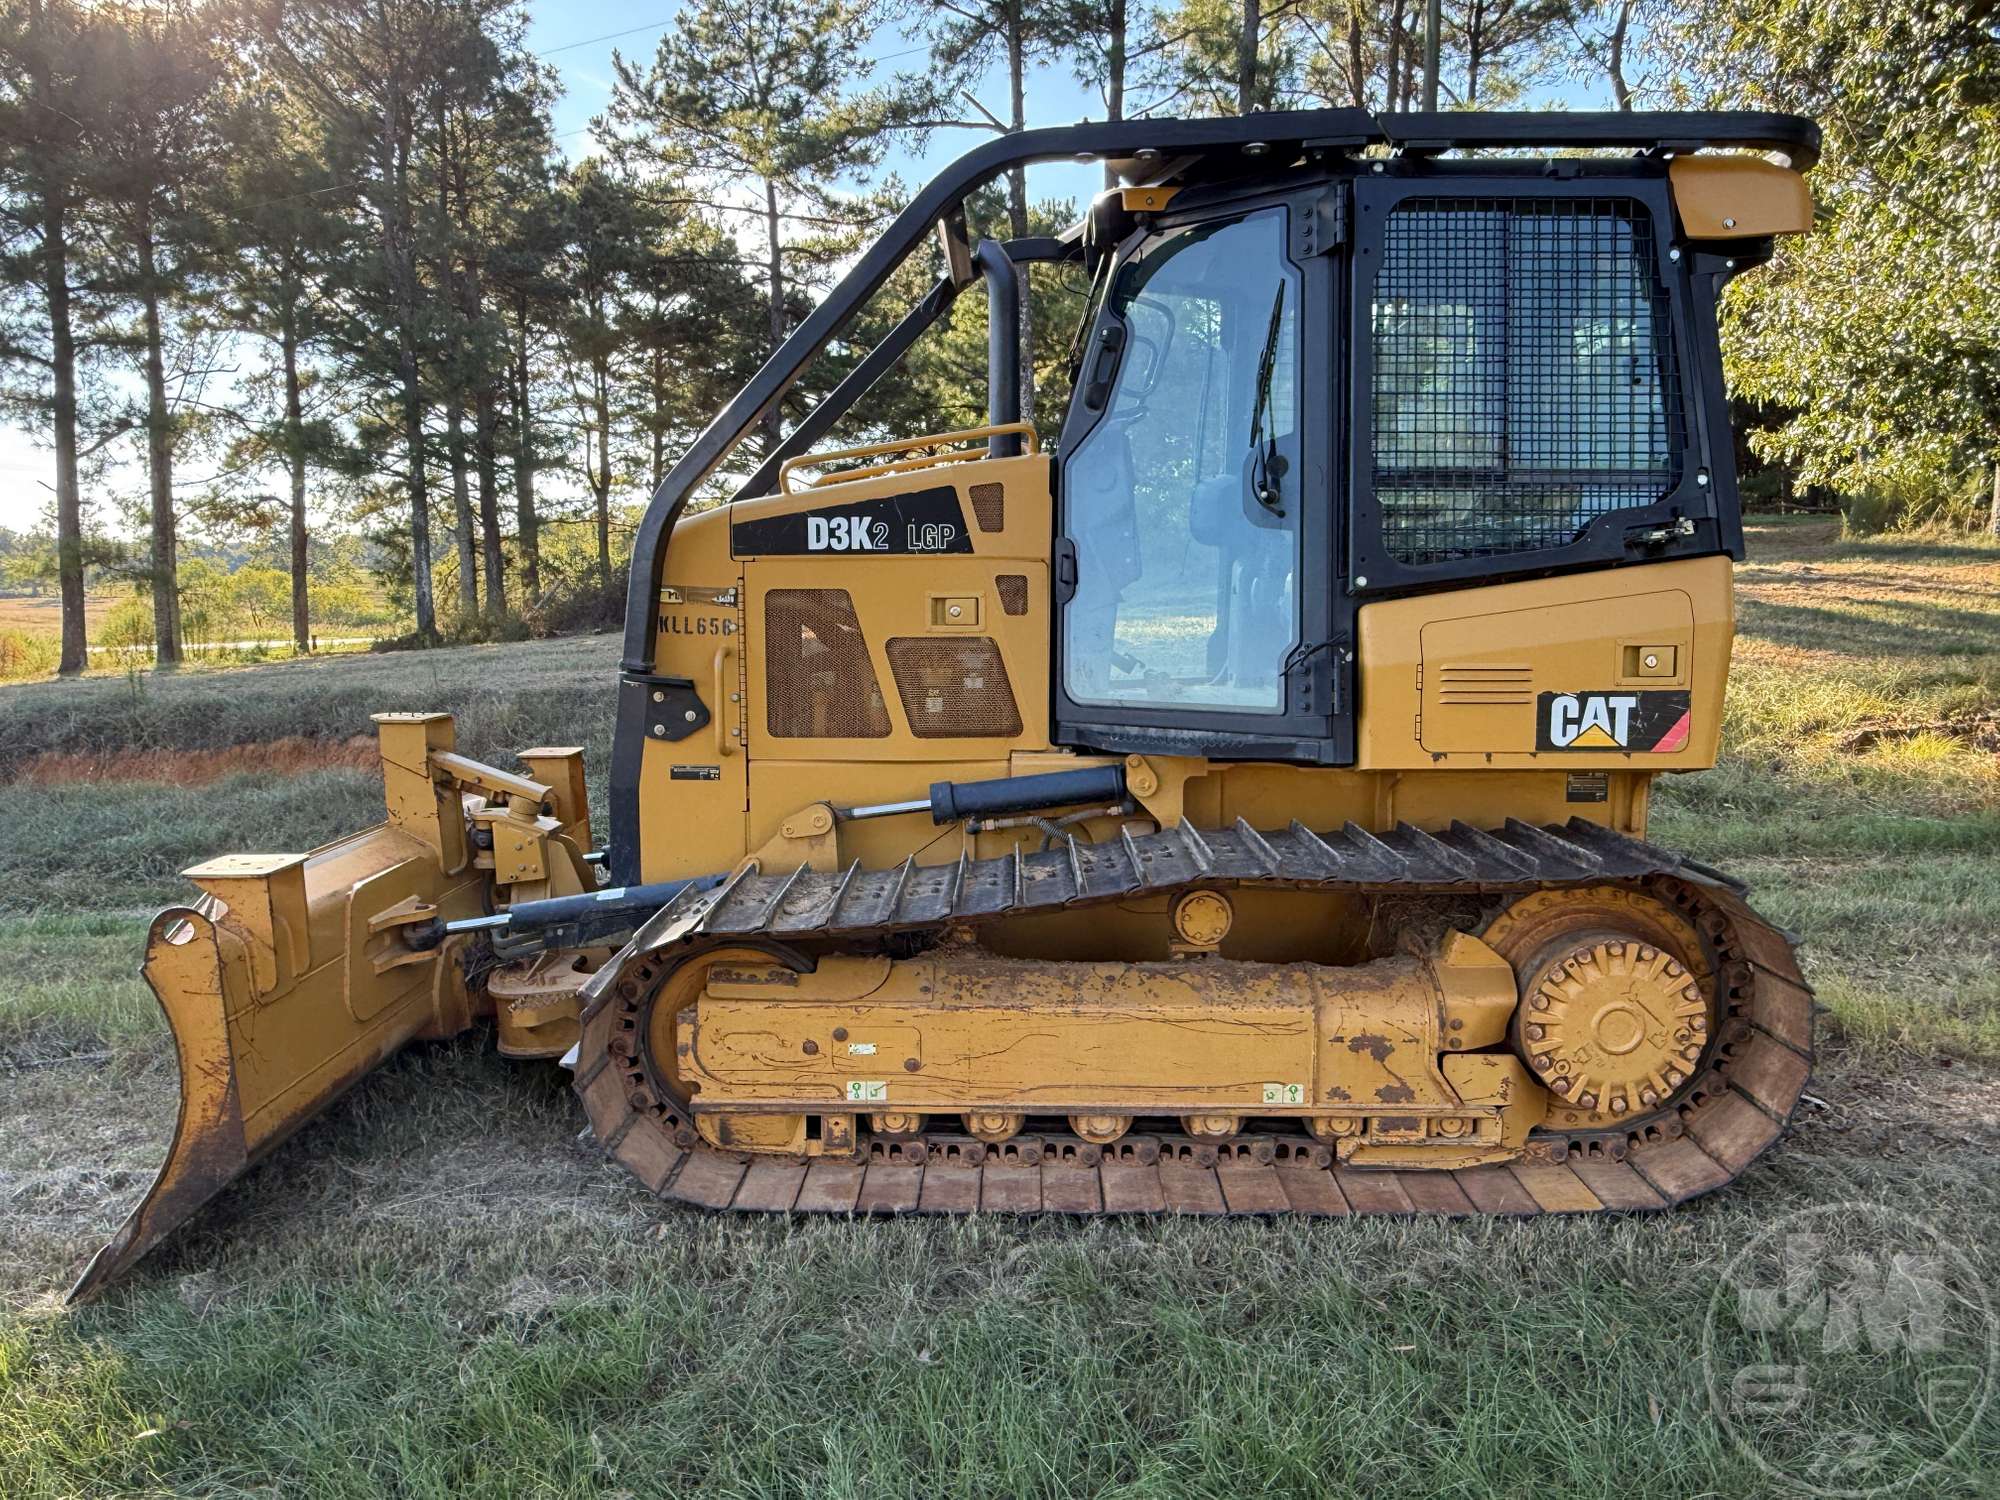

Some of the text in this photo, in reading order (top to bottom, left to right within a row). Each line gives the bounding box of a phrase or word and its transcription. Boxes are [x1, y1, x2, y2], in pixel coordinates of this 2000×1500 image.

[807, 516, 955, 550] D3K2 LGP
[1550, 696, 1637, 747] CAT
